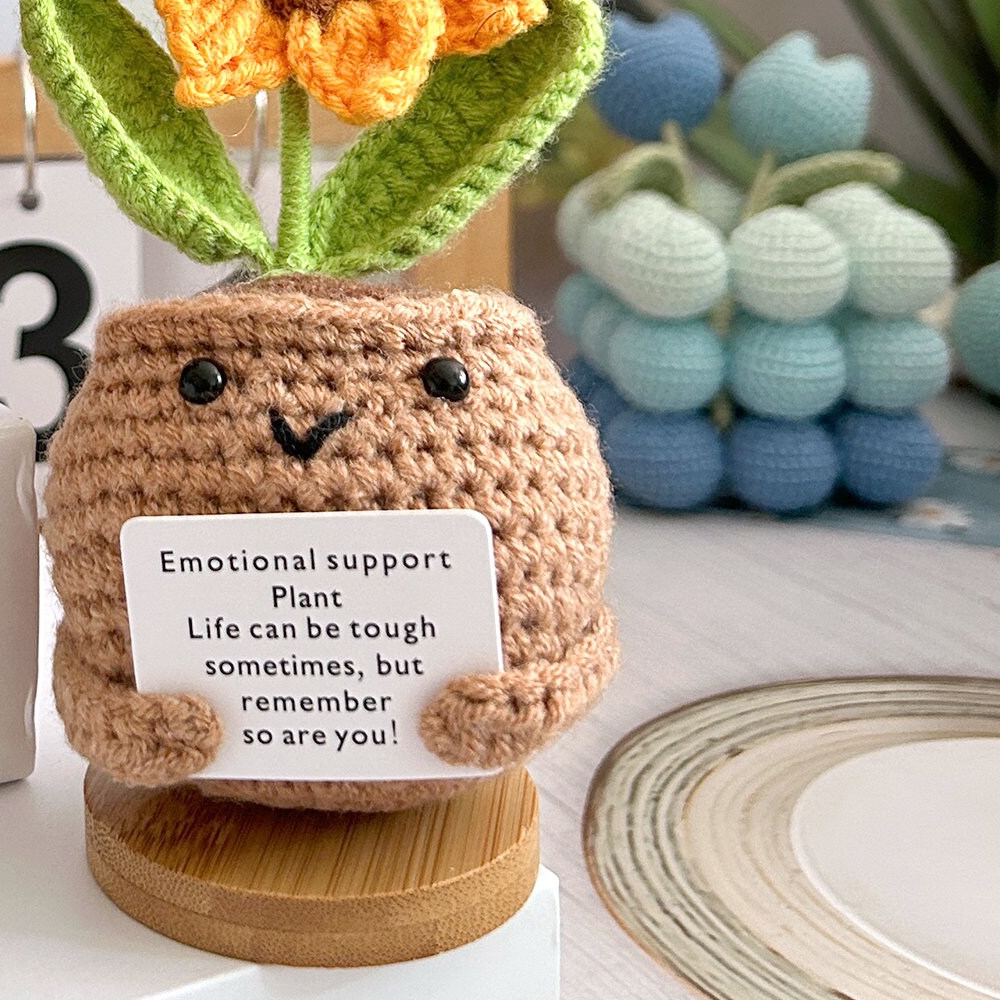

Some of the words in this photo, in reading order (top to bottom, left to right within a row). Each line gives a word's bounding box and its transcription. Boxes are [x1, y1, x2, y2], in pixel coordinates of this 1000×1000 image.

[160, 547, 316, 573] Emotional
[326, 549, 453, 577] support
[271, 585, 343, 609] Plant
[187, 616, 241, 640] Life
[249, 623, 296, 639] can
[306, 616, 341, 639] be
[349, 615, 437, 645] tough
[204, 654, 364, 681] sometimes,
[376, 653, 425, 677] but
[240, 689, 392, 712] remember
[242, 728, 273, 746] so
[282, 729, 327, 746] are
[334, 719, 398, 752] you!
